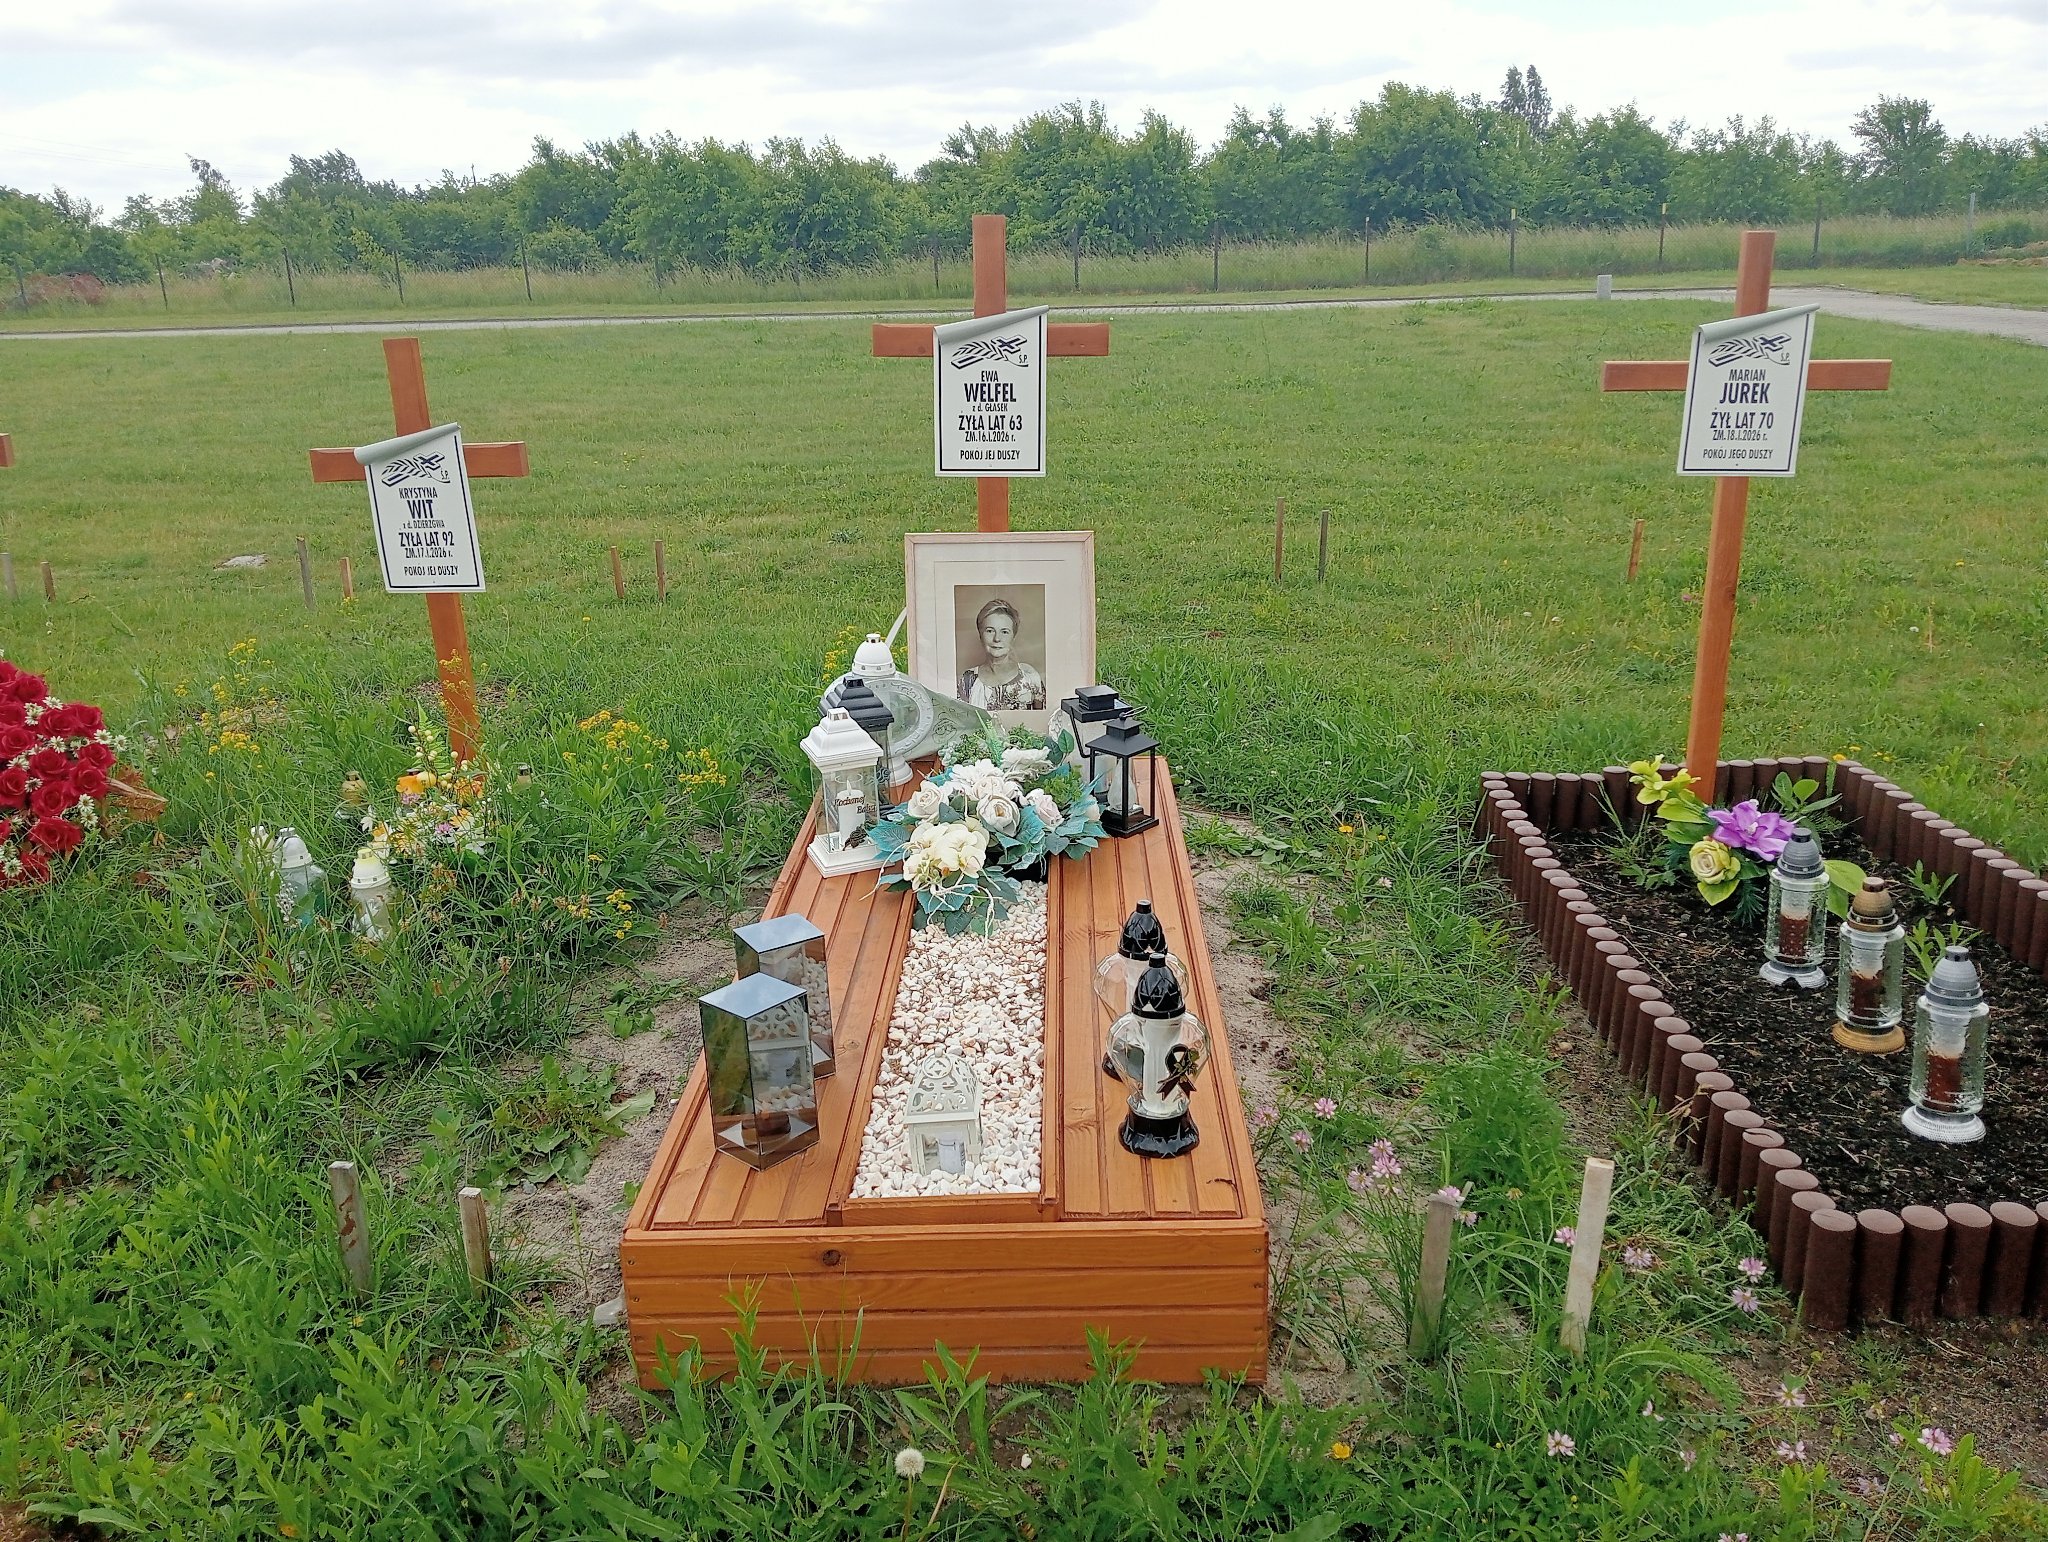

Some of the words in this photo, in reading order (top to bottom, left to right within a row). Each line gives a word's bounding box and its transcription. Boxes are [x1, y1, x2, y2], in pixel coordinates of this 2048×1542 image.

[981, 371, 998, 382] EWA
[1729, 369, 1766, 381] MARIAN
[964, 383, 1016, 402] WELFEL
[1719, 383, 1770, 404] JUREK
[959, 410, 984, 430] ŻYŁA
[988, 415, 1006, 430] LAT
[1009, 415, 1022, 430] 63
[1710, 408, 1731, 429] ŻYŁ
[1735, 412, 1756, 429] LAT
[1759, 412, 1774, 429] 70
[960, 447, 983, 460] POKÓJ
[985, 450, 995, 460] JEJ
[998, 450, 1020, 460] DUSZY
[1703, 447, 1727, 459] POKÓJ
[1728, 449, 1747, 459] JEGO
[1749, 449, 1773, 459] DUSZY
[399, 487, 438, 498] KRYSTYNA
[407, 500, 434, 519] WIT
[425, 532, 440, 546] LAT
[442, 531, 455, 546] 92
[427, 566, 436, 575] JEJ
[438, 565, 459, 576] DUSZY
